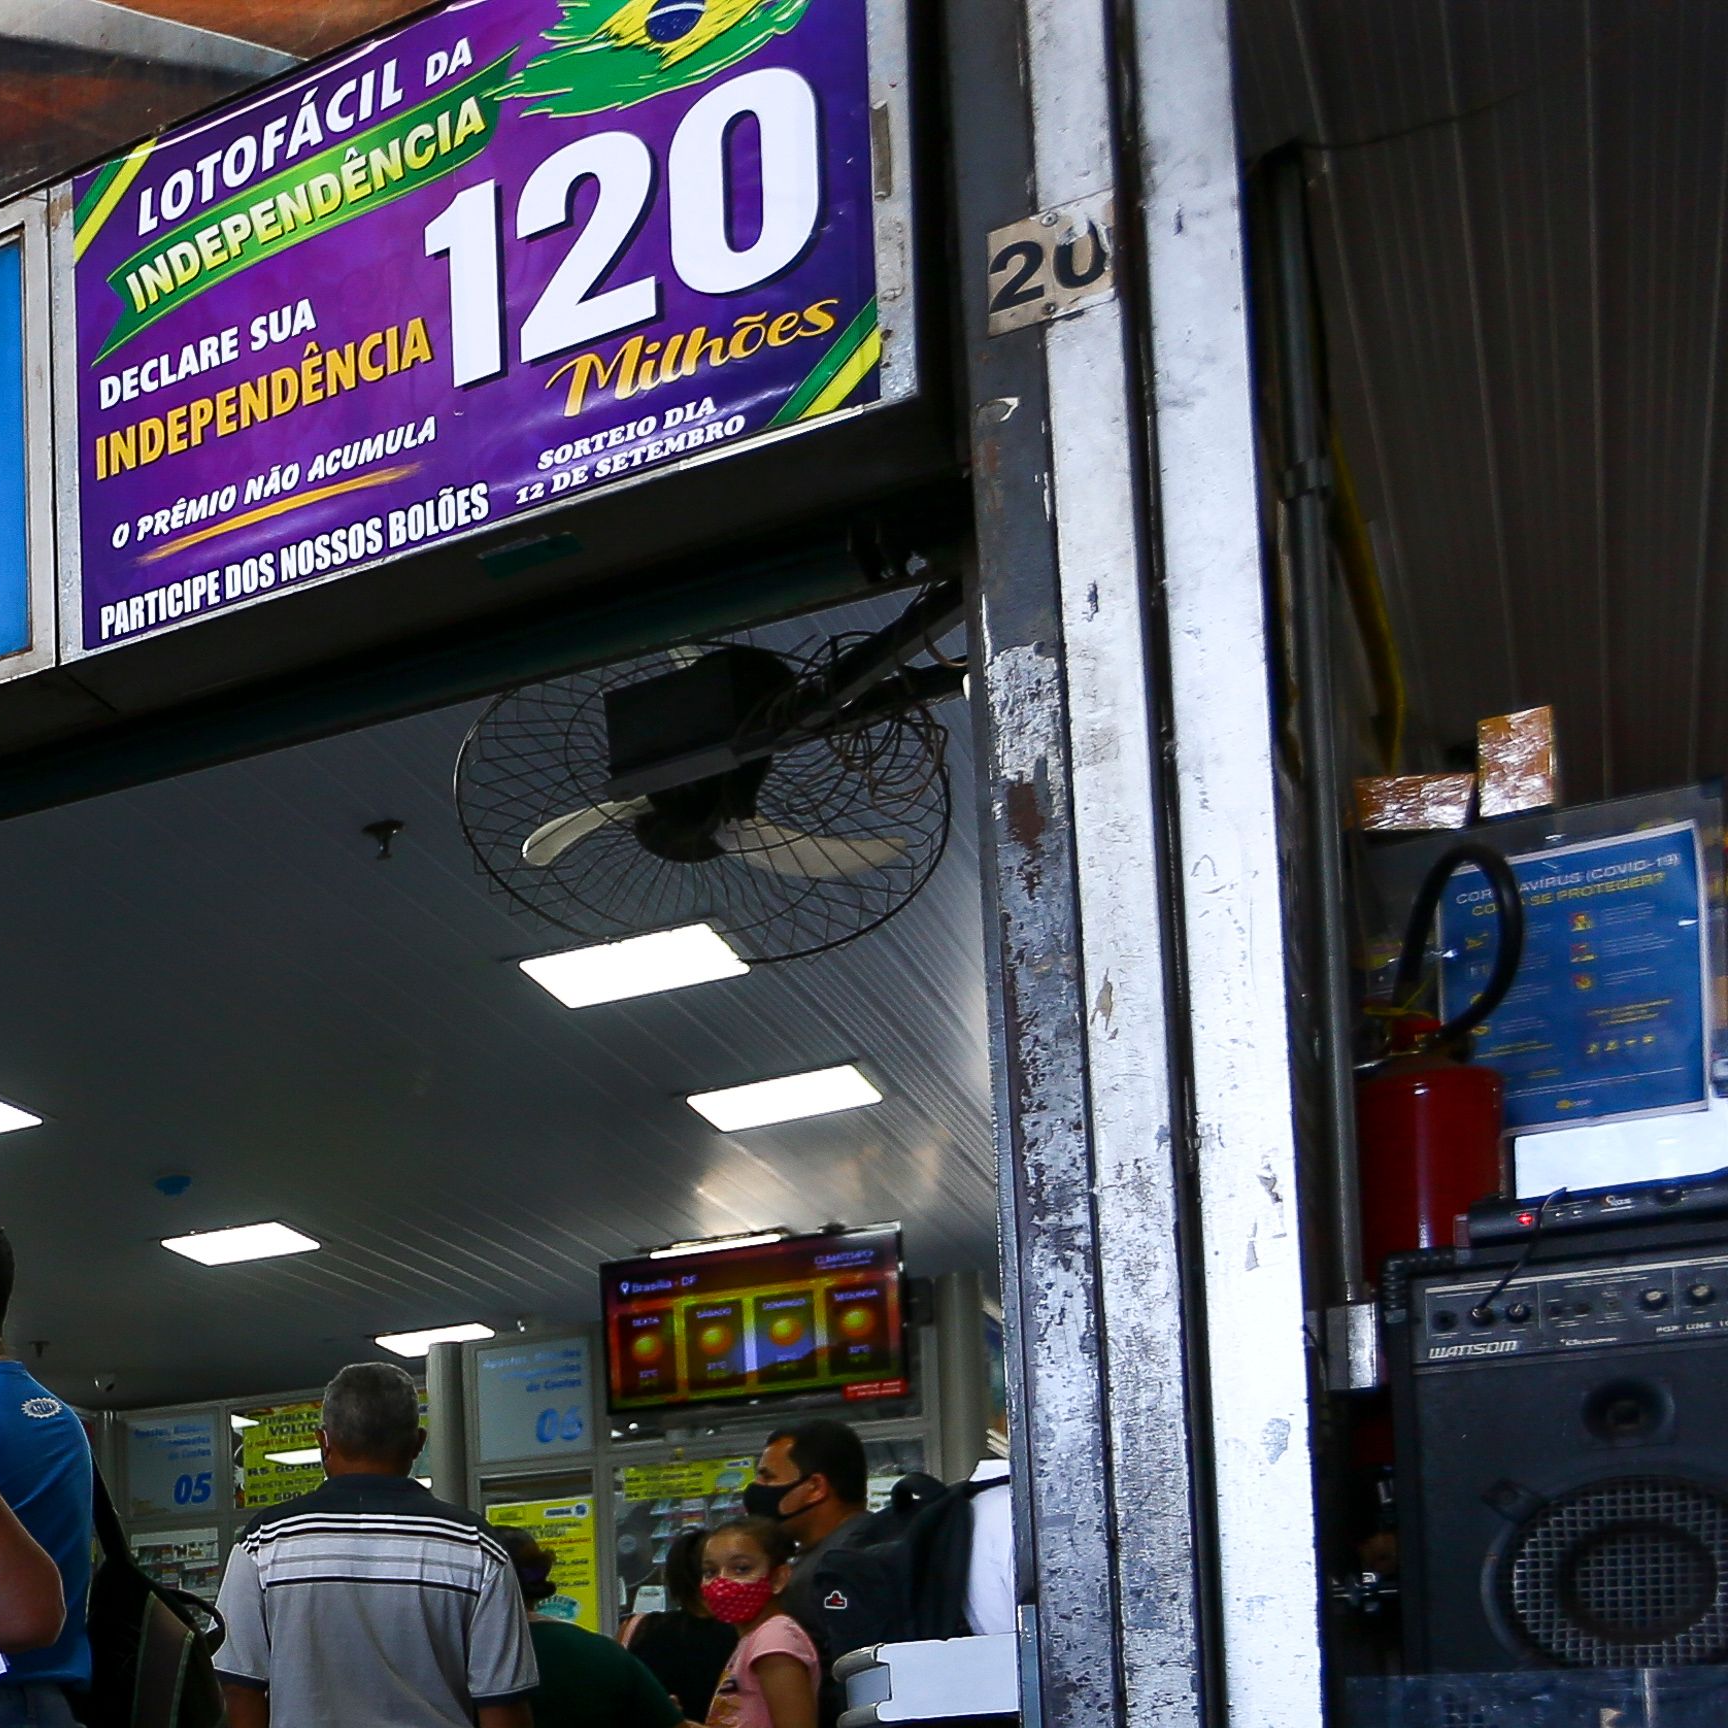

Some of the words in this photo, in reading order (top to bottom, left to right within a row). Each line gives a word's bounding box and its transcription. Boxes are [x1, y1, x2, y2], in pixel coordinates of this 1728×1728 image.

[137, 62, 404, 236] LOTOFÁCIL
[424, 38, 473, 82] DA
[126, 97, 487, 314] INDEPENDÊNCIA
[424, 67, 820, 388] 120
[95, 319, 433, 480] INDEPENDÊNCIA
[99, 326, 239, 410] DECLARE
[251, 299, 316, 354] SUA
[546, 298, 839, 418] Milhões
[111, 521, 130, 549] O
[137, 485, 237, 542] PRÊMIO
[243, 461, 300, 508] NÃO
[308, 417, 436, 485] ACUMULA
[515, 480, 545, 505] 12
[550, 468, 588, 496] DE
[592, 415, 746, 485] SETEMBRO
[536, 415, 657, 470] SORTEIO
[663, 398, 717, 436] DIA
[100, 568, 220, 638] PARTICIPE
[225, 553, 275, 600] DOS
[280, 517, 384, 585] NOSSOS
[389, 483, 490, 555] BOLÕES
[1456, 871, 1584, 905] CORAVIRUS
[1587, 852, 1681, 881] (COVID-19)
[1530, 892, 1553, 907] SE
[682, 1275, 697, 1286] DF
[535, 1405, 583, 1444] 06
[173, 1472, 213, 1505] 05
